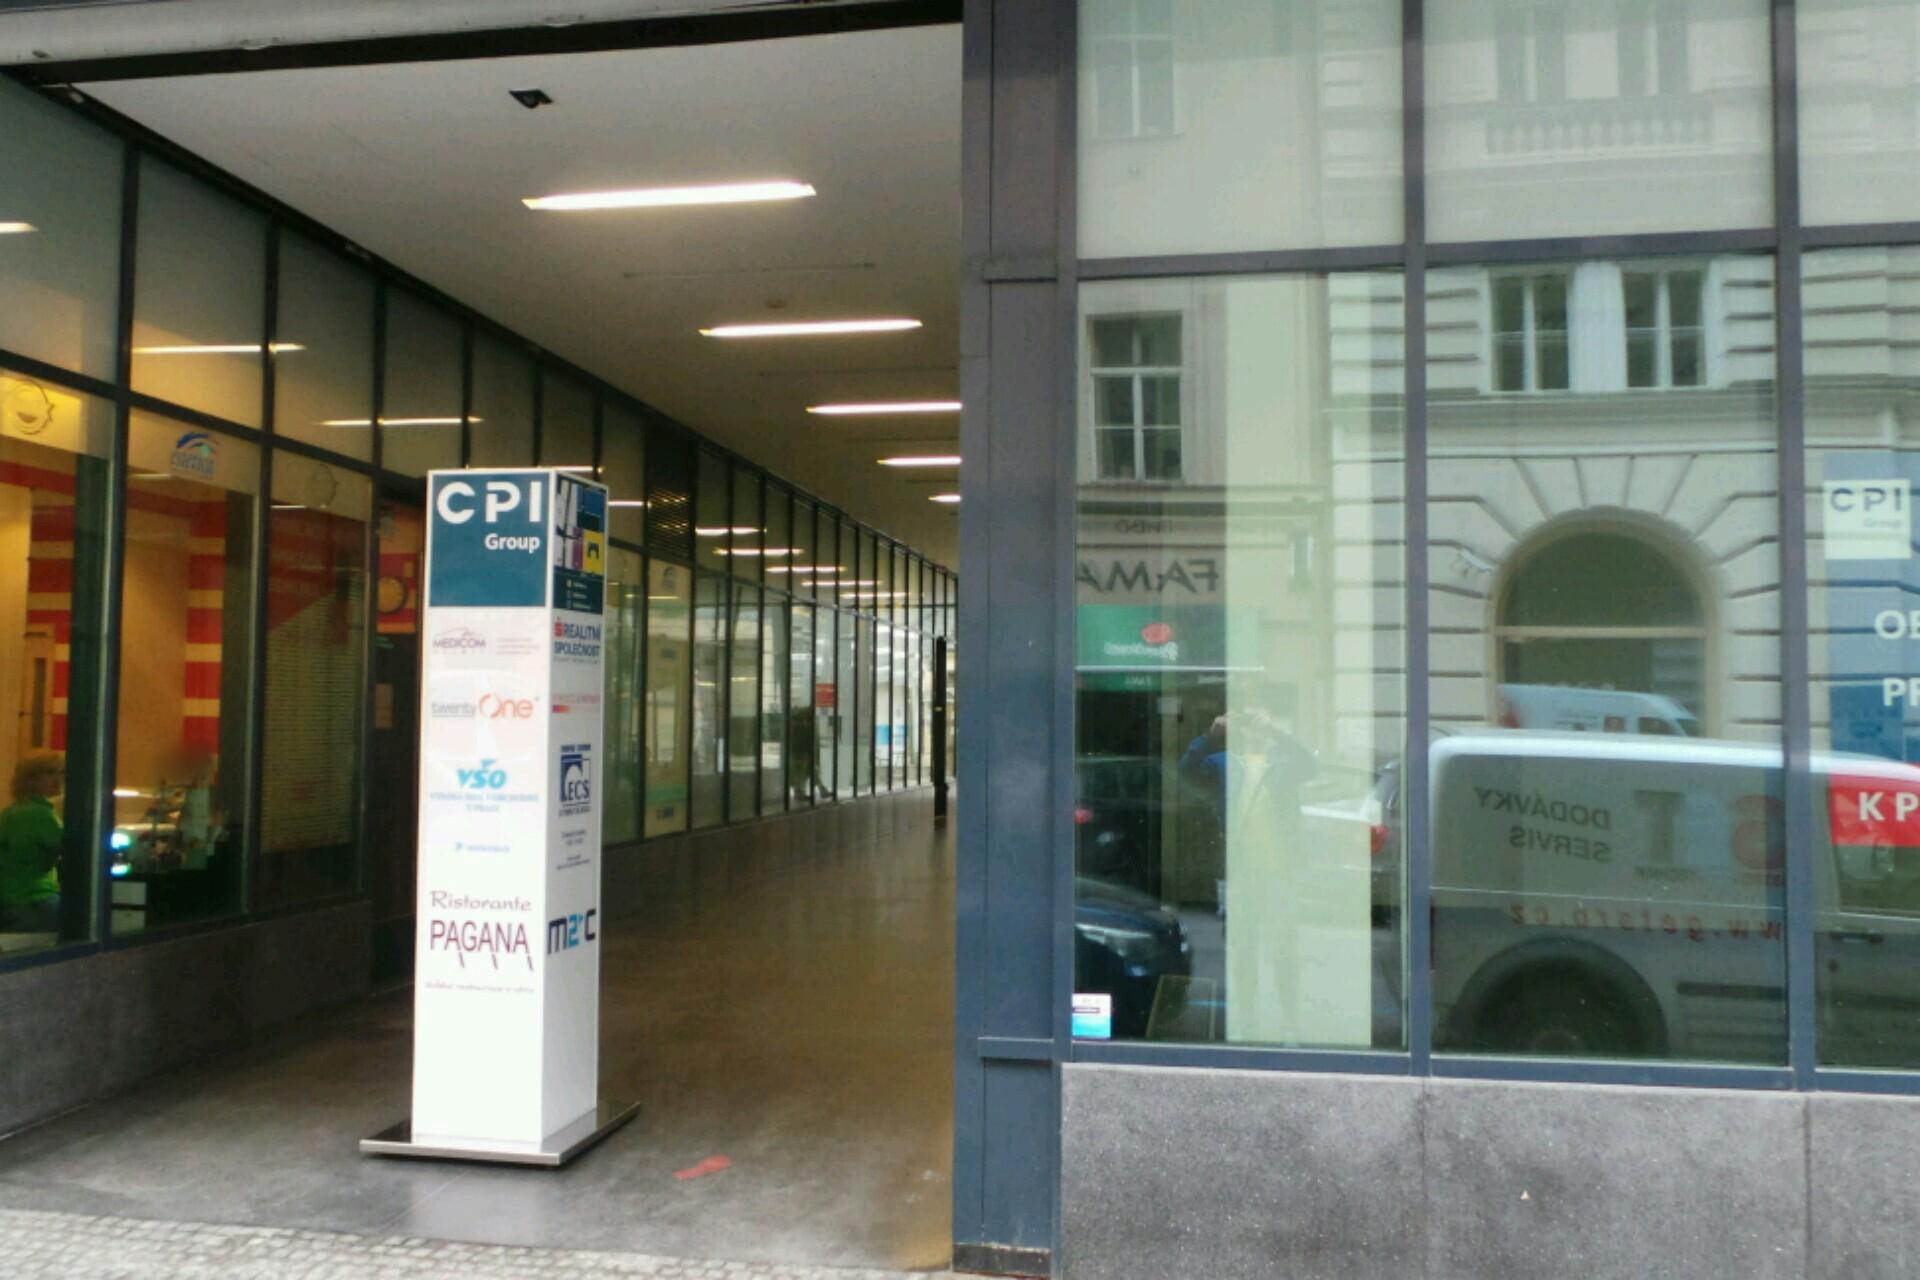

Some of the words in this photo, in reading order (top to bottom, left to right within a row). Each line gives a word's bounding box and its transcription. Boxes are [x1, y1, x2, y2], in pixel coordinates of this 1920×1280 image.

[436, 481, 543, 525] CPI
[1829, 487, 1902, 513] CPI
[484, 532, 541, 554] Group
[432, 637, 487, 649] MEDICOM
[568, 779, 590, 801] ECS
[1858, 791, 1885, 821] K
[430, 889, 532, 912] Ristorante
[430, 919, 535, 972] PAGANA
